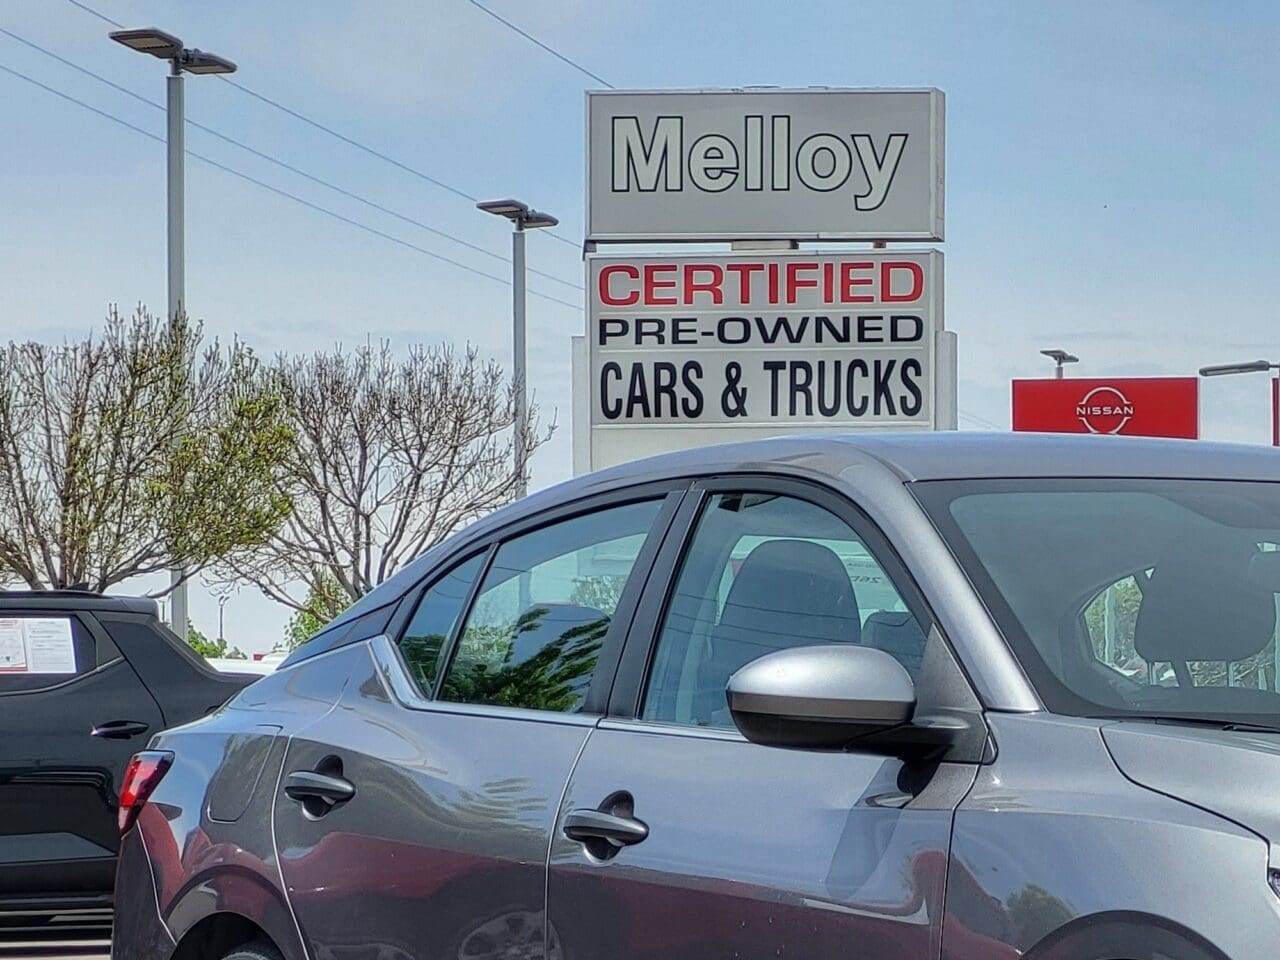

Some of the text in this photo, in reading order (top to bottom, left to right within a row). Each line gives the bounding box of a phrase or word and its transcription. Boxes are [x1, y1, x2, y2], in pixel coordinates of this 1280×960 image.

[611, 115, 909, 212] Melloy
[598, 261, 925, 307] CERTIFIED
[599, 315, 924, 346] PRE-OWNED
[600, 358, 923, 420] CARS & TRUCKS
[1076, 406, 1134, 415] NISSAN
